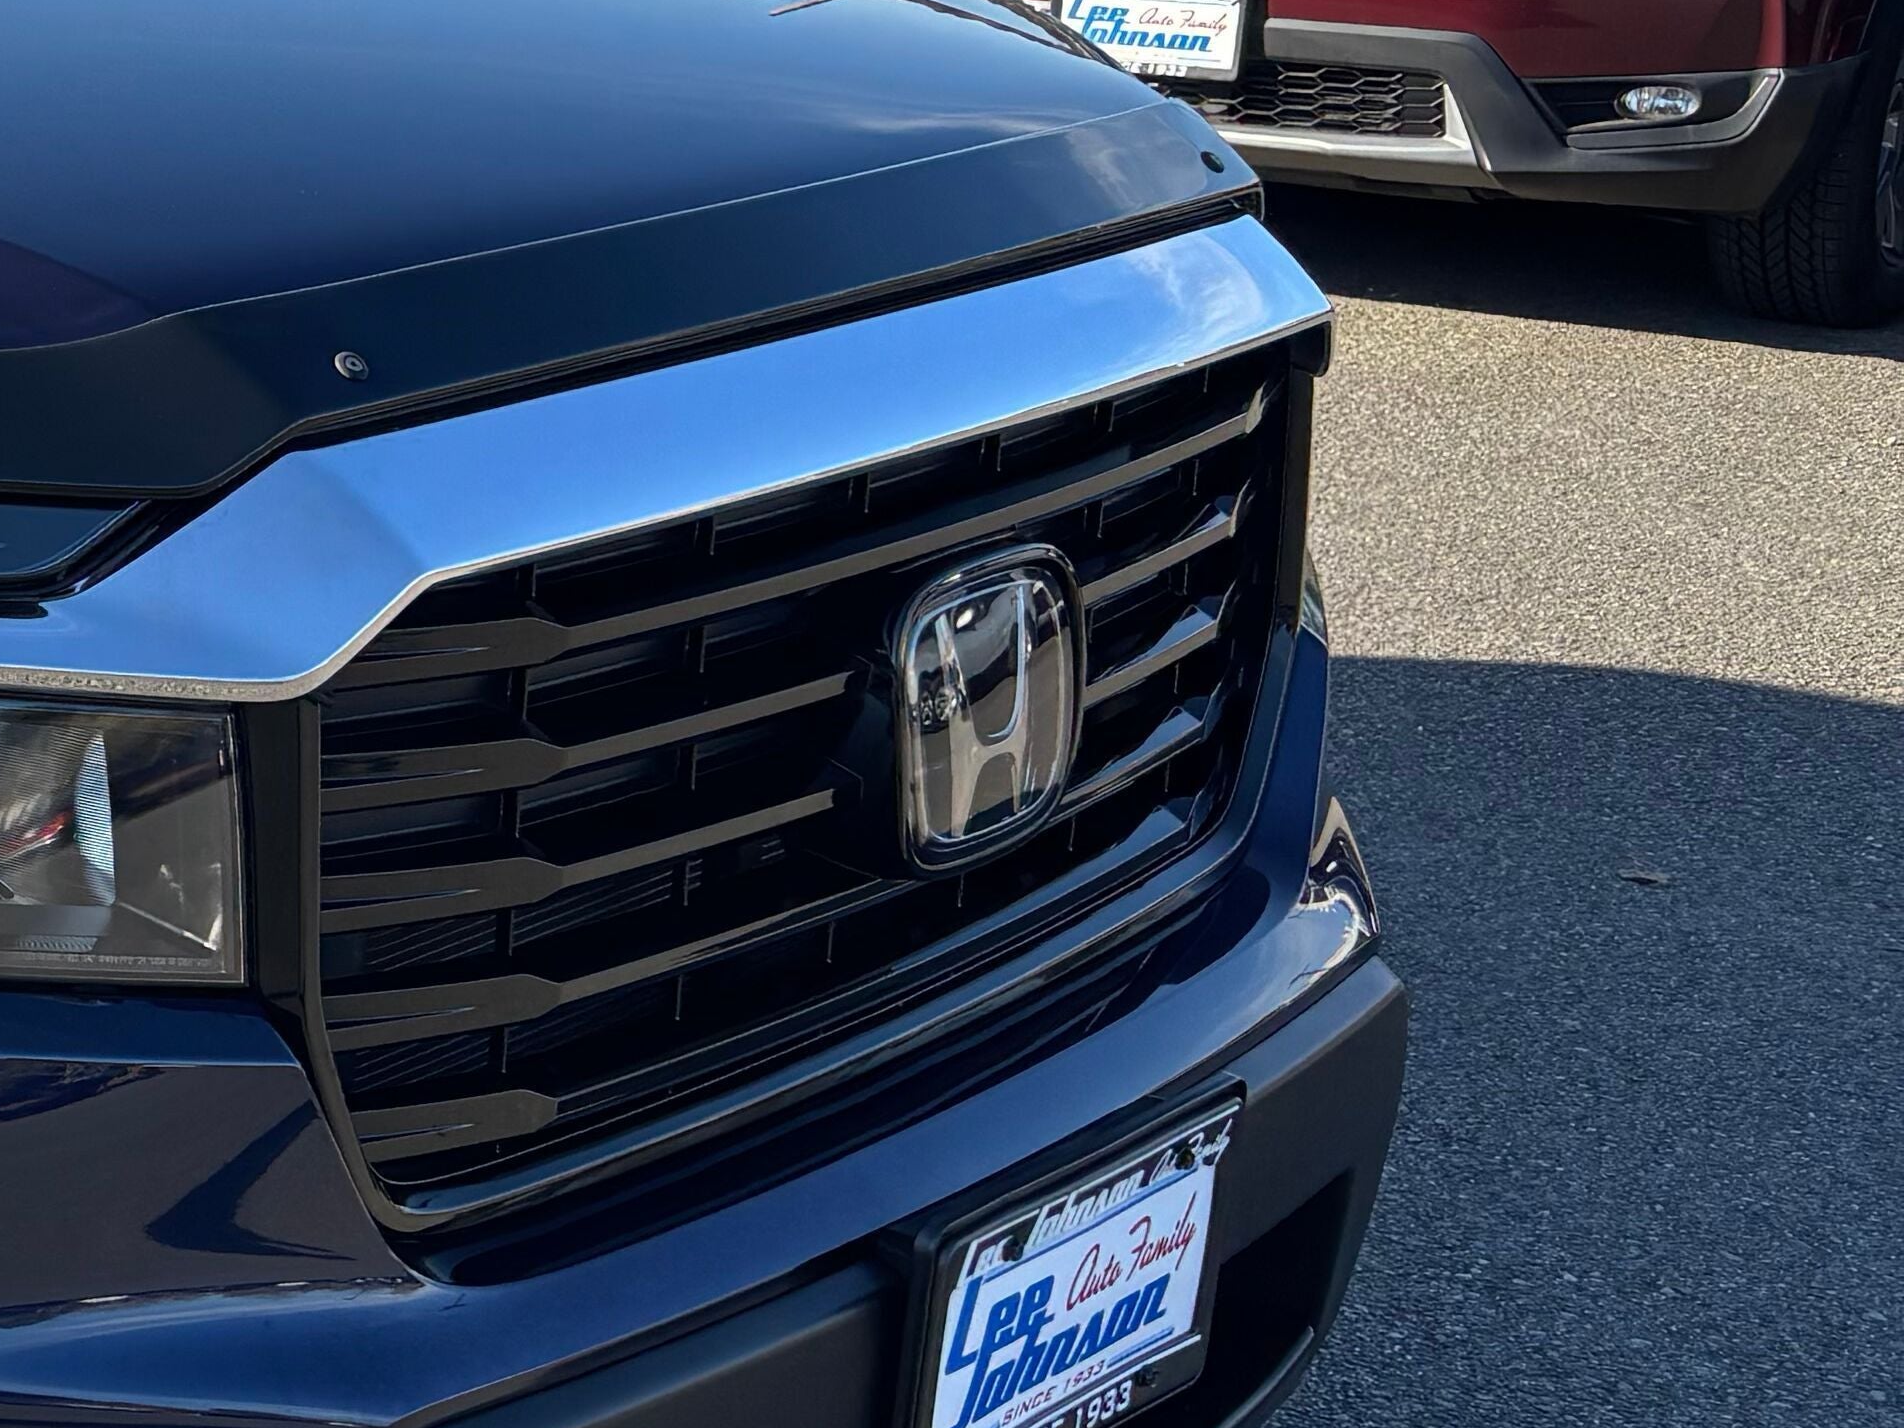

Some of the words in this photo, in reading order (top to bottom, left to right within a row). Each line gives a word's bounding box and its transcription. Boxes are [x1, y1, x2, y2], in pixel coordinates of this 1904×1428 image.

[1138, 7, 1174, 26] Auto
[1180, 9, 1228, 37] Family
[944, 1274, 1055, 1376] Lee
[1065, 1243, 1123, 1312] Auto
[1125, 1191, 1197, 1282] Family
[1002, 1385, 1057, 1427] SINCE
[1063, 1359, 1107, 1394] 1933
